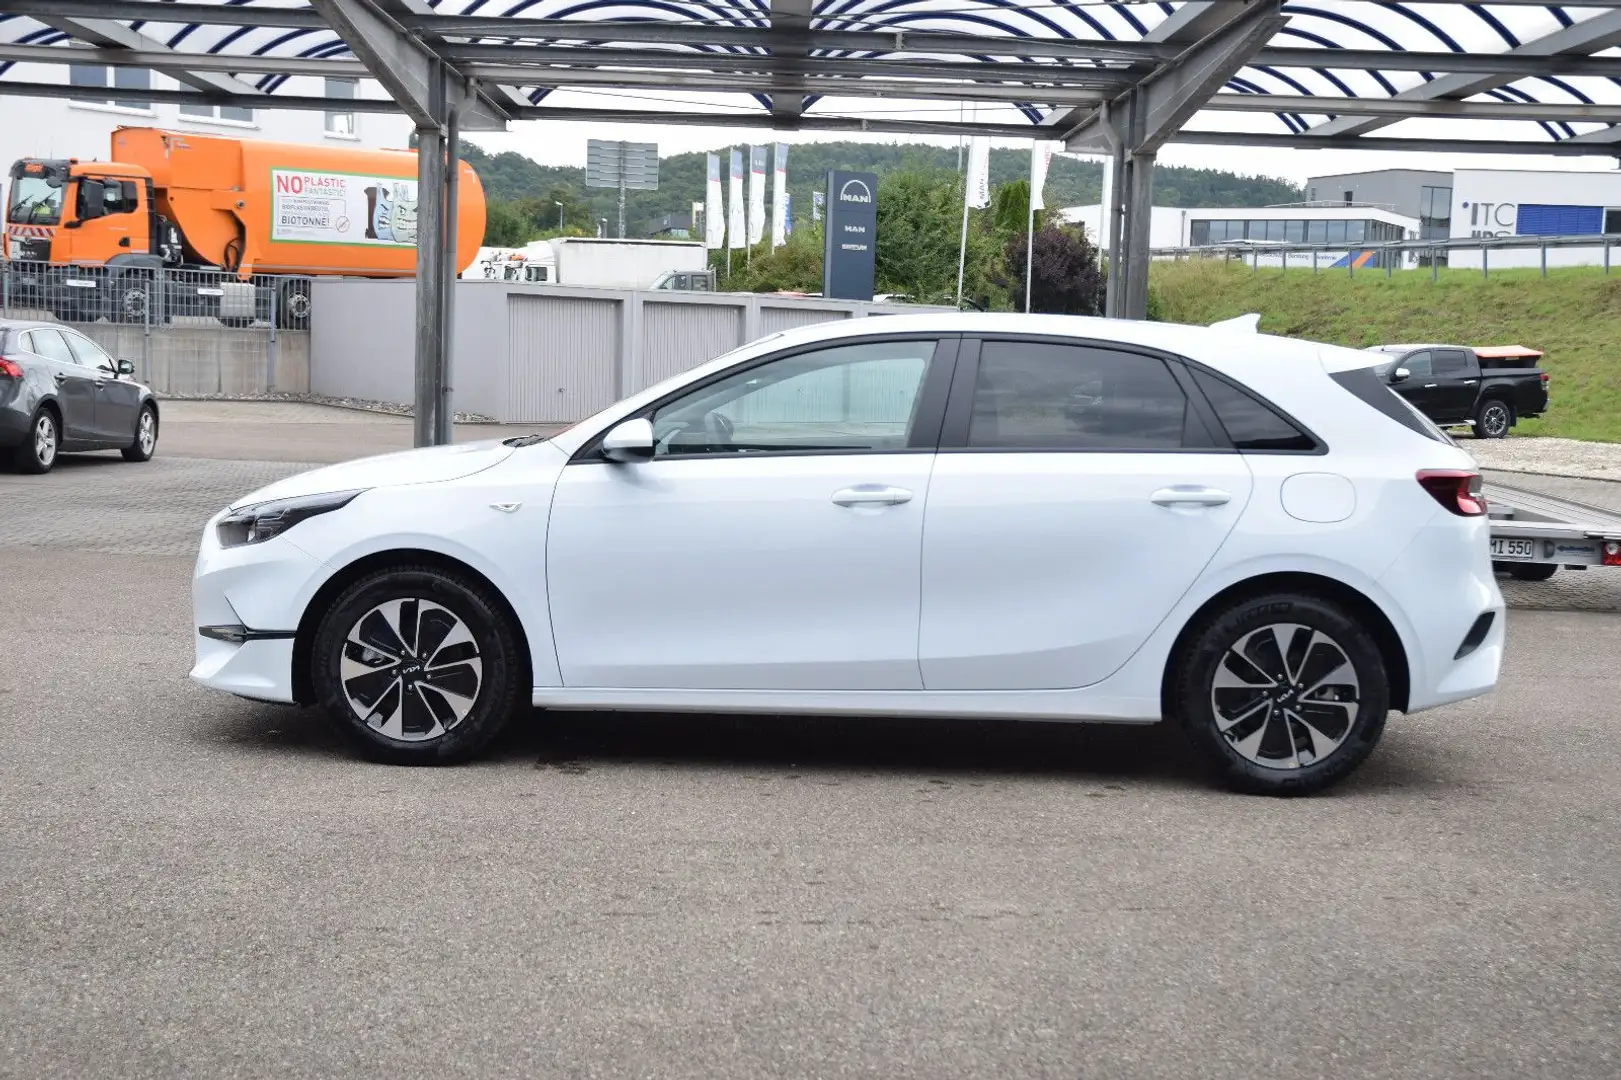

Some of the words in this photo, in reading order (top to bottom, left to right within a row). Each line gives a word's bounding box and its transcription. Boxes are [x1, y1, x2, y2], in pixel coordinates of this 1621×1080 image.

[276, 175, 303, 194] NO
[843, 193, 869, 203] MAN
[281, 215, 330, 226] BIOTONNE!
[1471, 202, 1516, 227] ITC
[844, 225, 866, 233] MAN
[1508, 540, 1532, 555] 550
